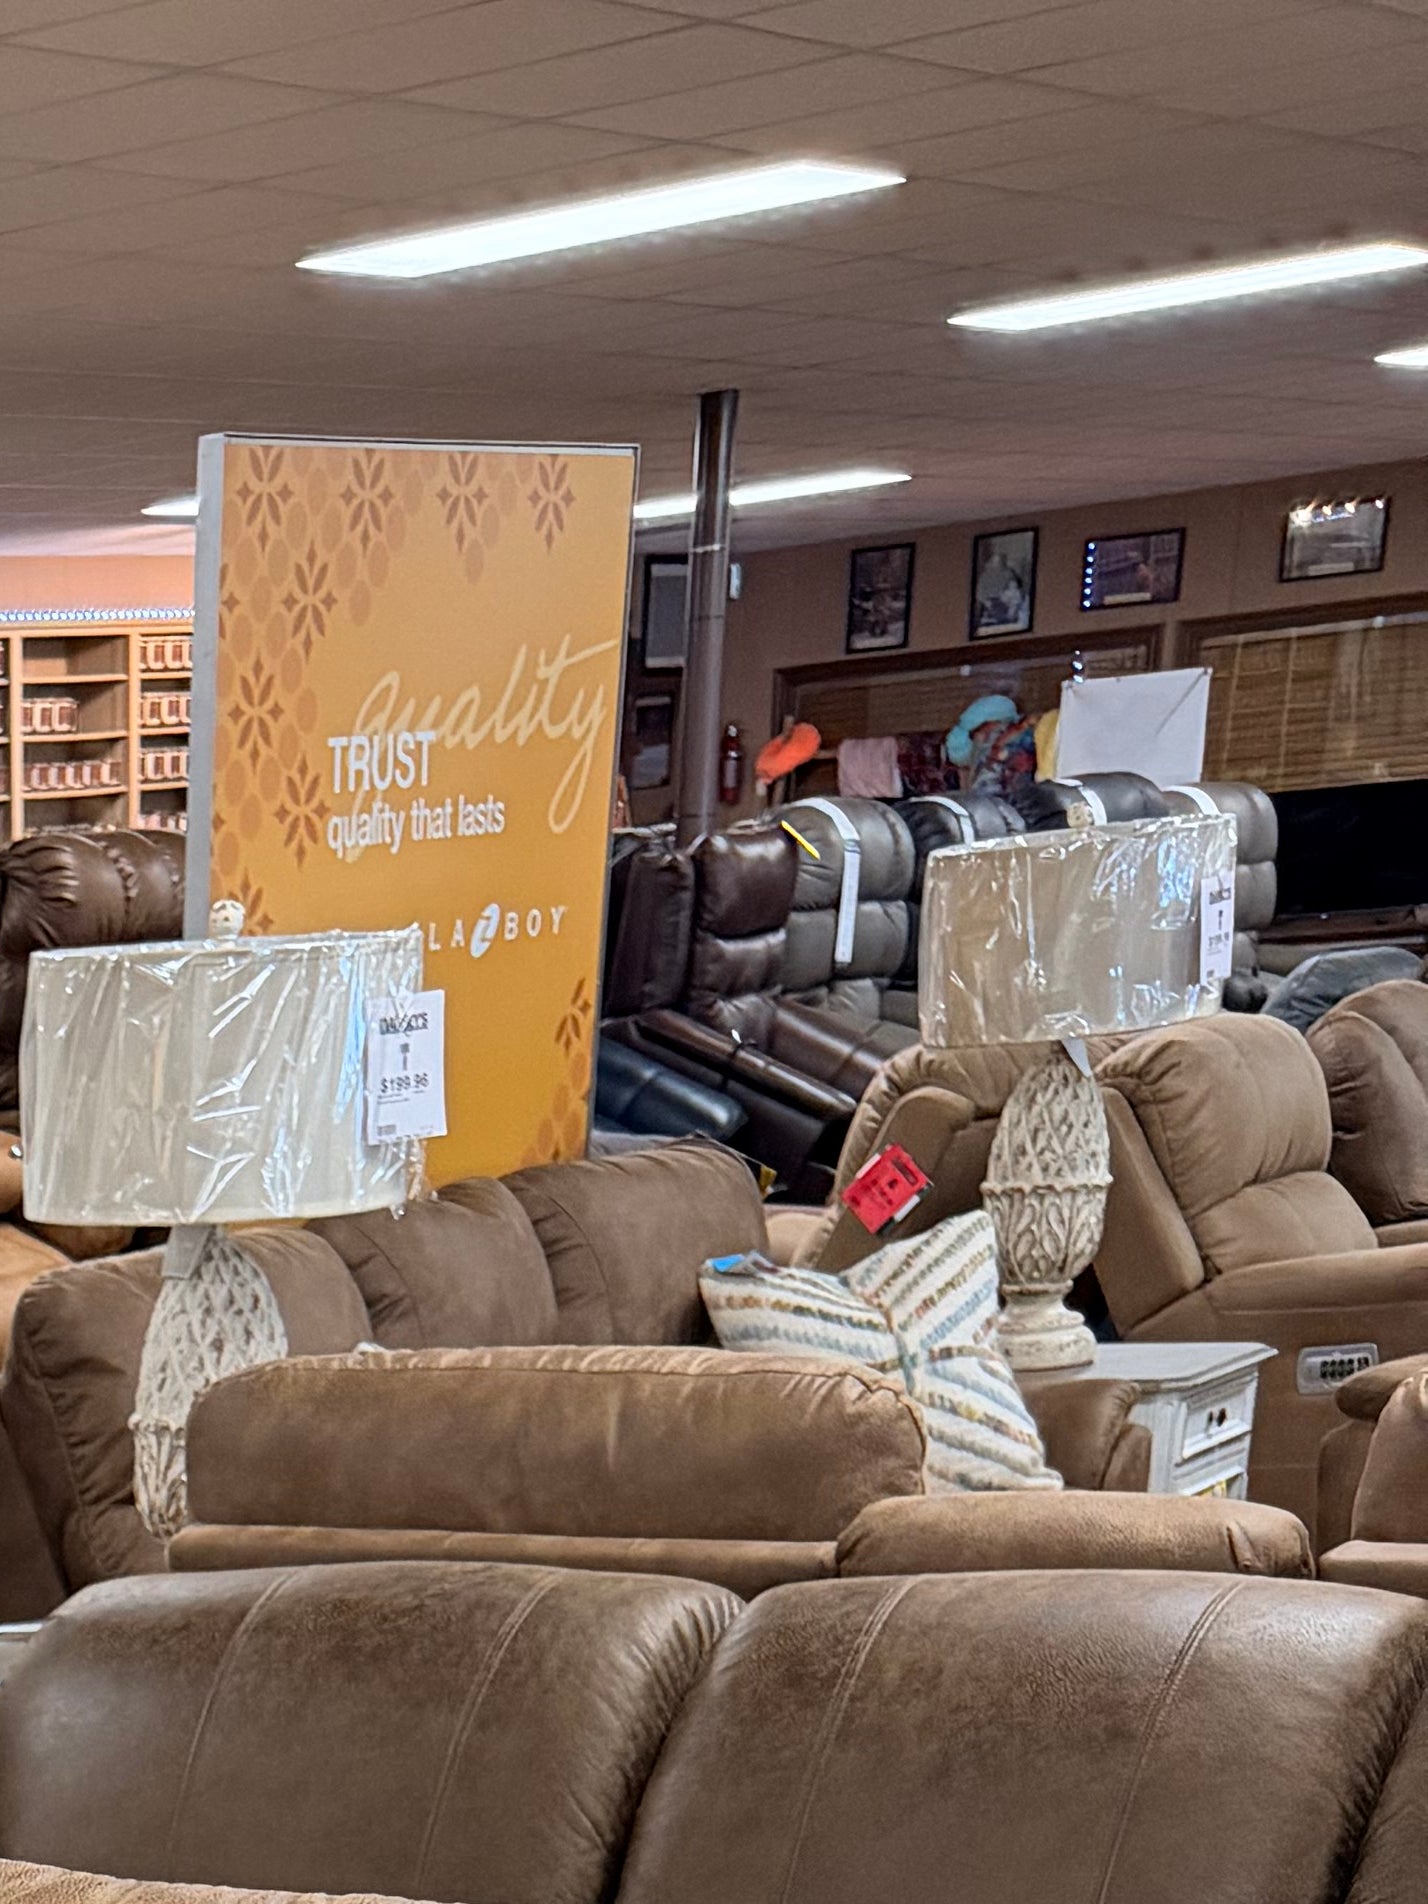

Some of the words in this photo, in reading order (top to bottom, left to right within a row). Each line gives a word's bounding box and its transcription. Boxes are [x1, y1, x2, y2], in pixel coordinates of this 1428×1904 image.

[328, 730, 436, 793] TRUST
[327, 800, 405, 858] quality
[410, 797, 452, 840] that
[458, 794, 505, 836] lasts
